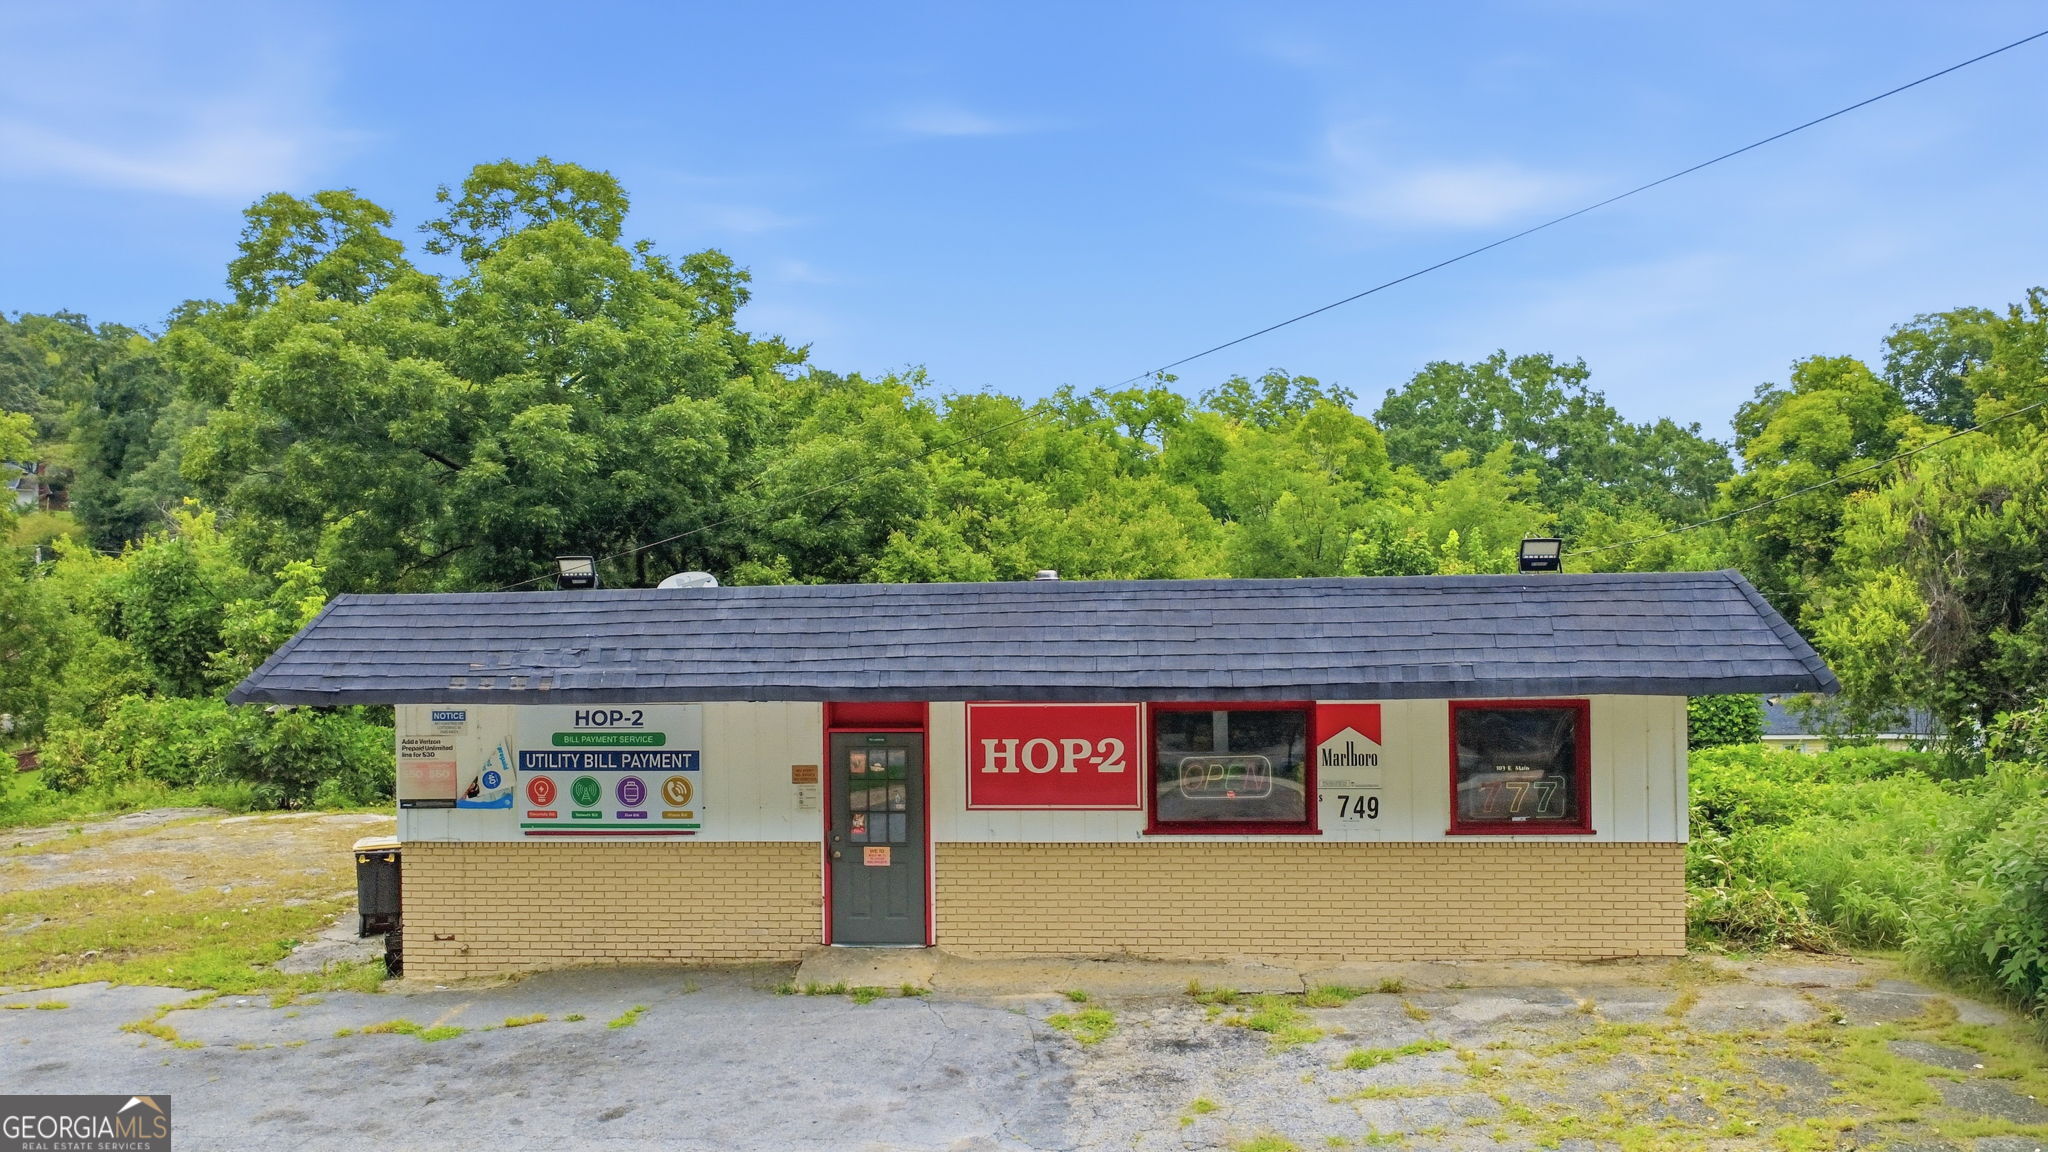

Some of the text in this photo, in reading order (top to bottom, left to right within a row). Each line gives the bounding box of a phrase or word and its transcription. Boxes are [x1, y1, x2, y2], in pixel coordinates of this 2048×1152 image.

[433, 712, 464, 720] NOTICE
[575, 710, 643, 726] HOP-2
[526, 753, 692, 768] UTILITY BILL PAYMENT
[980, 738, 1126, 774] HOP-2
[1322, 741, 1378, 766] Marlboro
[1184, 762, 1267, 792] OPEN
[1480, 781, 1558, 813] 777
